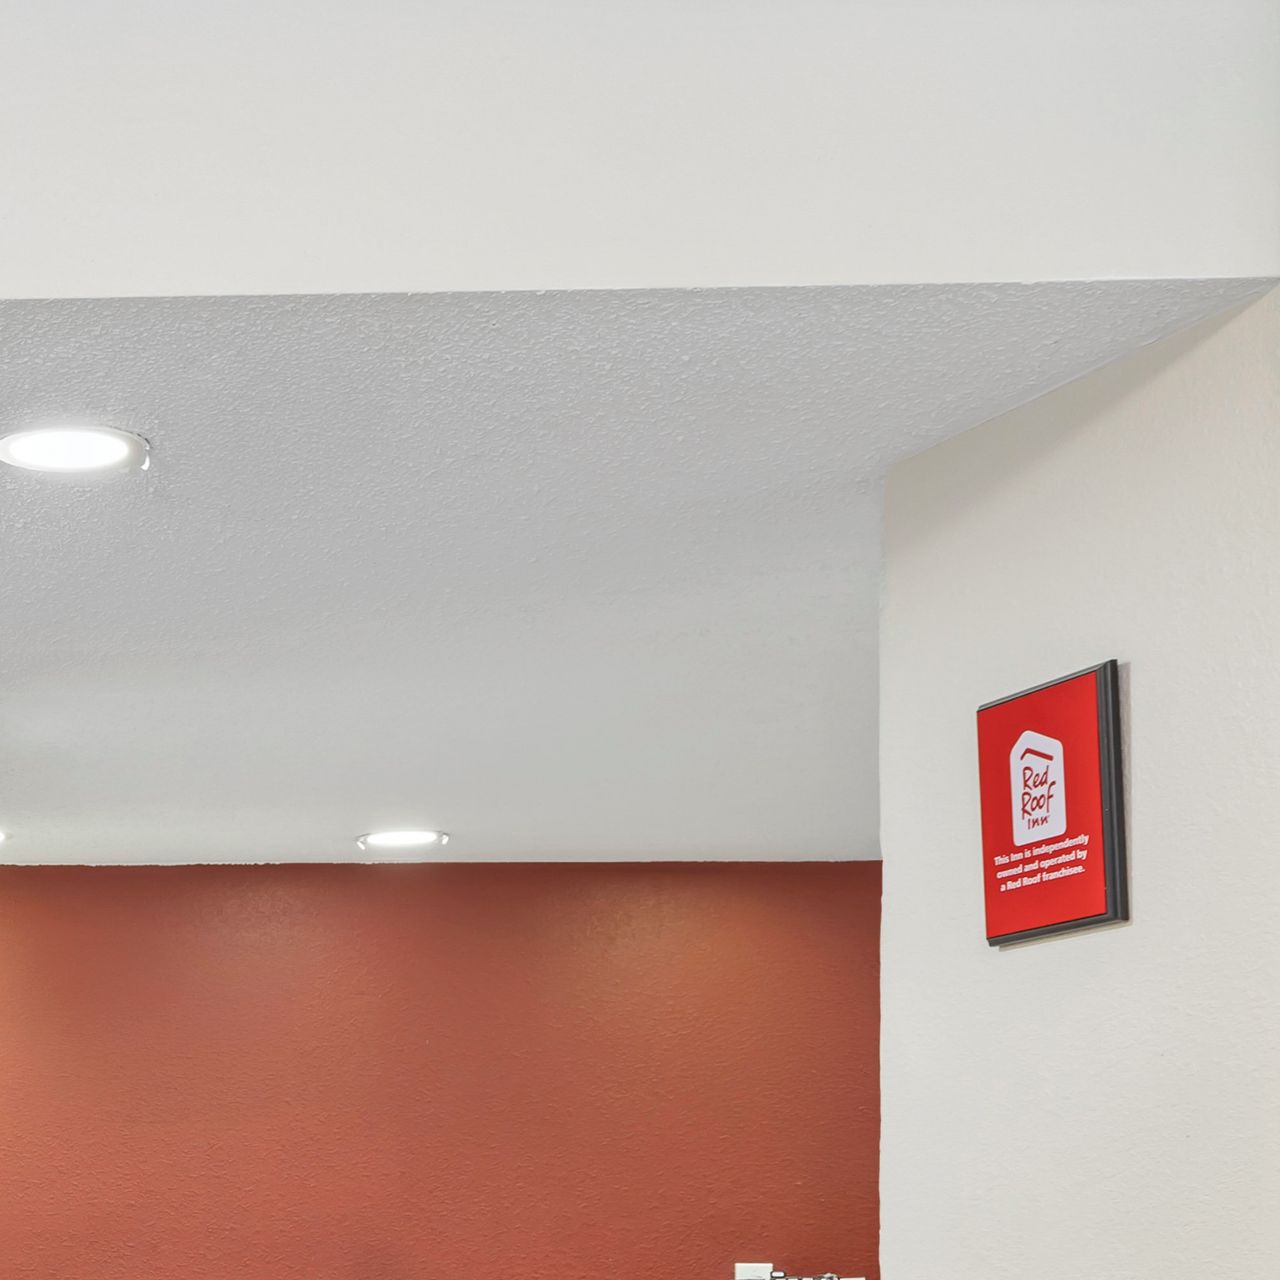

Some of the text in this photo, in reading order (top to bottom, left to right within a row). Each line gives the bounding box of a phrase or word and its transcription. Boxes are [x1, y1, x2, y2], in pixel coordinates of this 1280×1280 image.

[1022, 765, 1049, 791] Red
[1021, 780, 1056, 821] Roof
[993, 855, 1009, 866] This
[1024, 849, 1032, 858] is
[1032, 834, 1090, 856] independently
[996, 849, 1088, 879] owned and operated by
[1000, 865, 1086, 892] a Red Roof franchisee.
